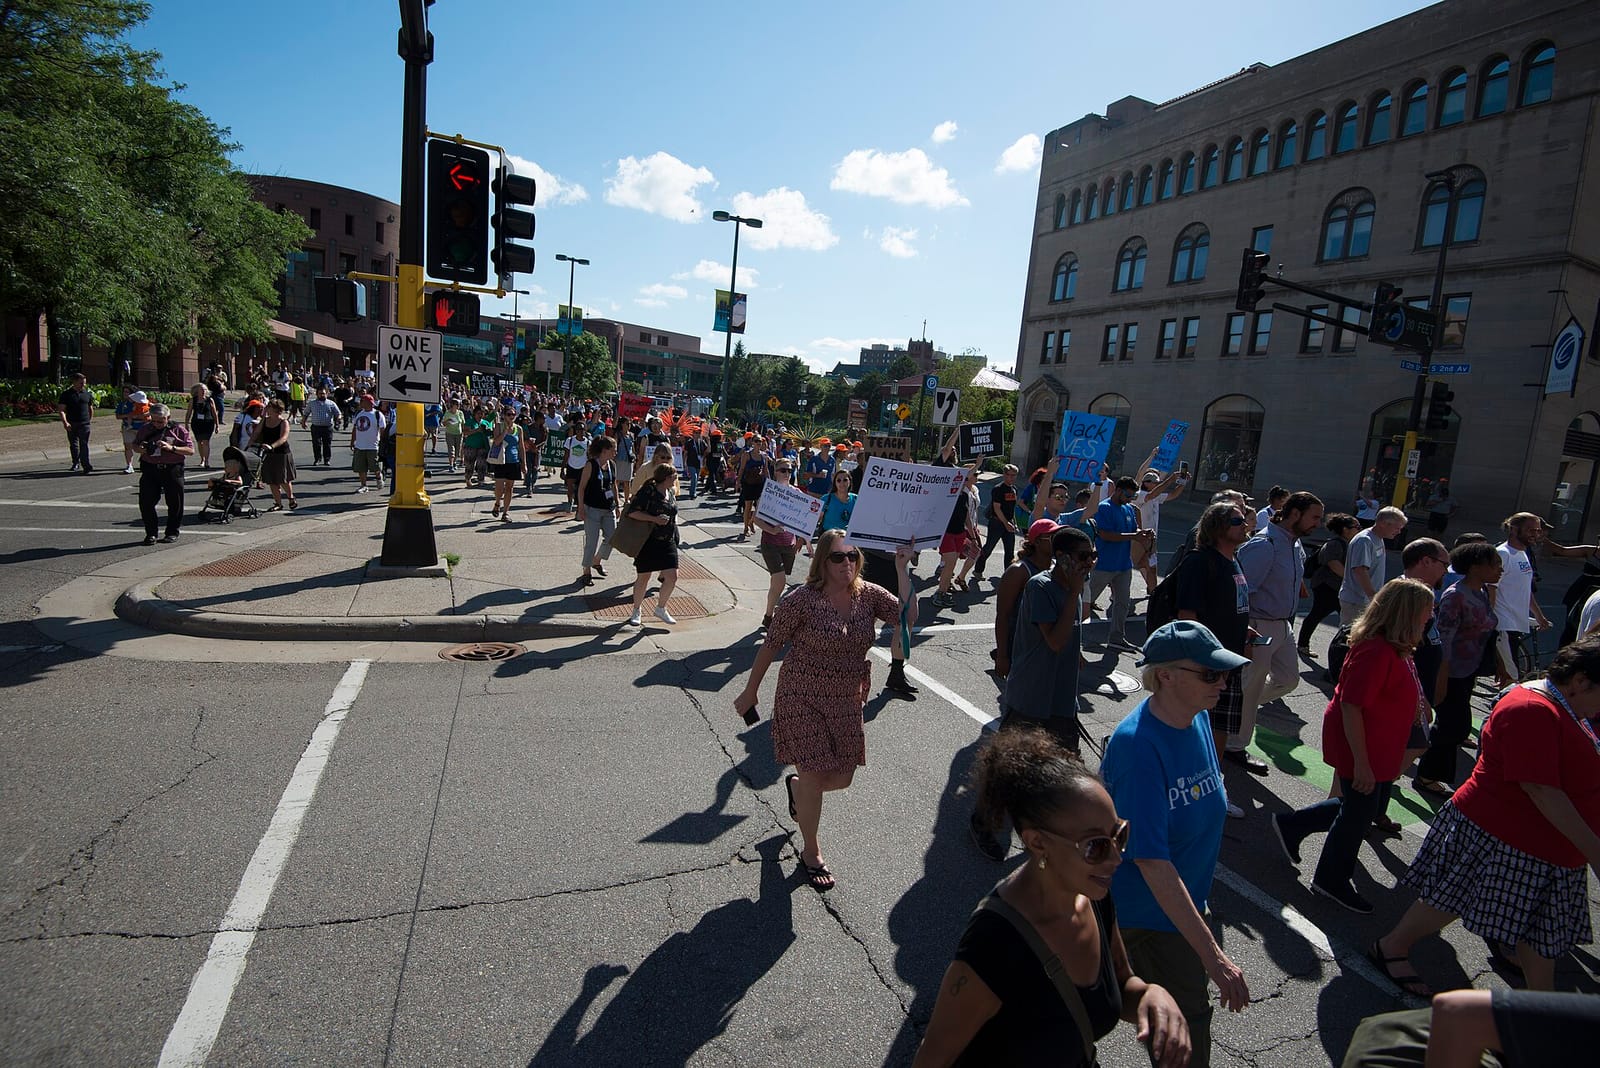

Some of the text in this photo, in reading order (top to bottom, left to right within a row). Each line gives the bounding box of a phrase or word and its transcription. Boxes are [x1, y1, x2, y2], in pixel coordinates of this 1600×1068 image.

[390, 334, 431, 353] ONE
[388, 353, 432, 373] WAY
[472, 375, 496, 383] BLACK
[473, 382, 496, 390] LIVES
[471, 388, 499, 397] MATTER
[971, 425, 992, 435] BLACK
[869, 437, 906, 449] TEACH
[973, 435, 991, 444] LIVES
[970, 443, 994, 454] MATTER
[871, 465, 886, 477] St.
[889, 468, 914, 481] Paul
[915, 472, 951, 485] Students
[867, 477, 898, 492] Can't
[900, 482, 922, 495] Wait
[774, 485, 785, 493] Paul
[786, 490, 809, 503] Students
[777, 492, 790, 501] Wait
